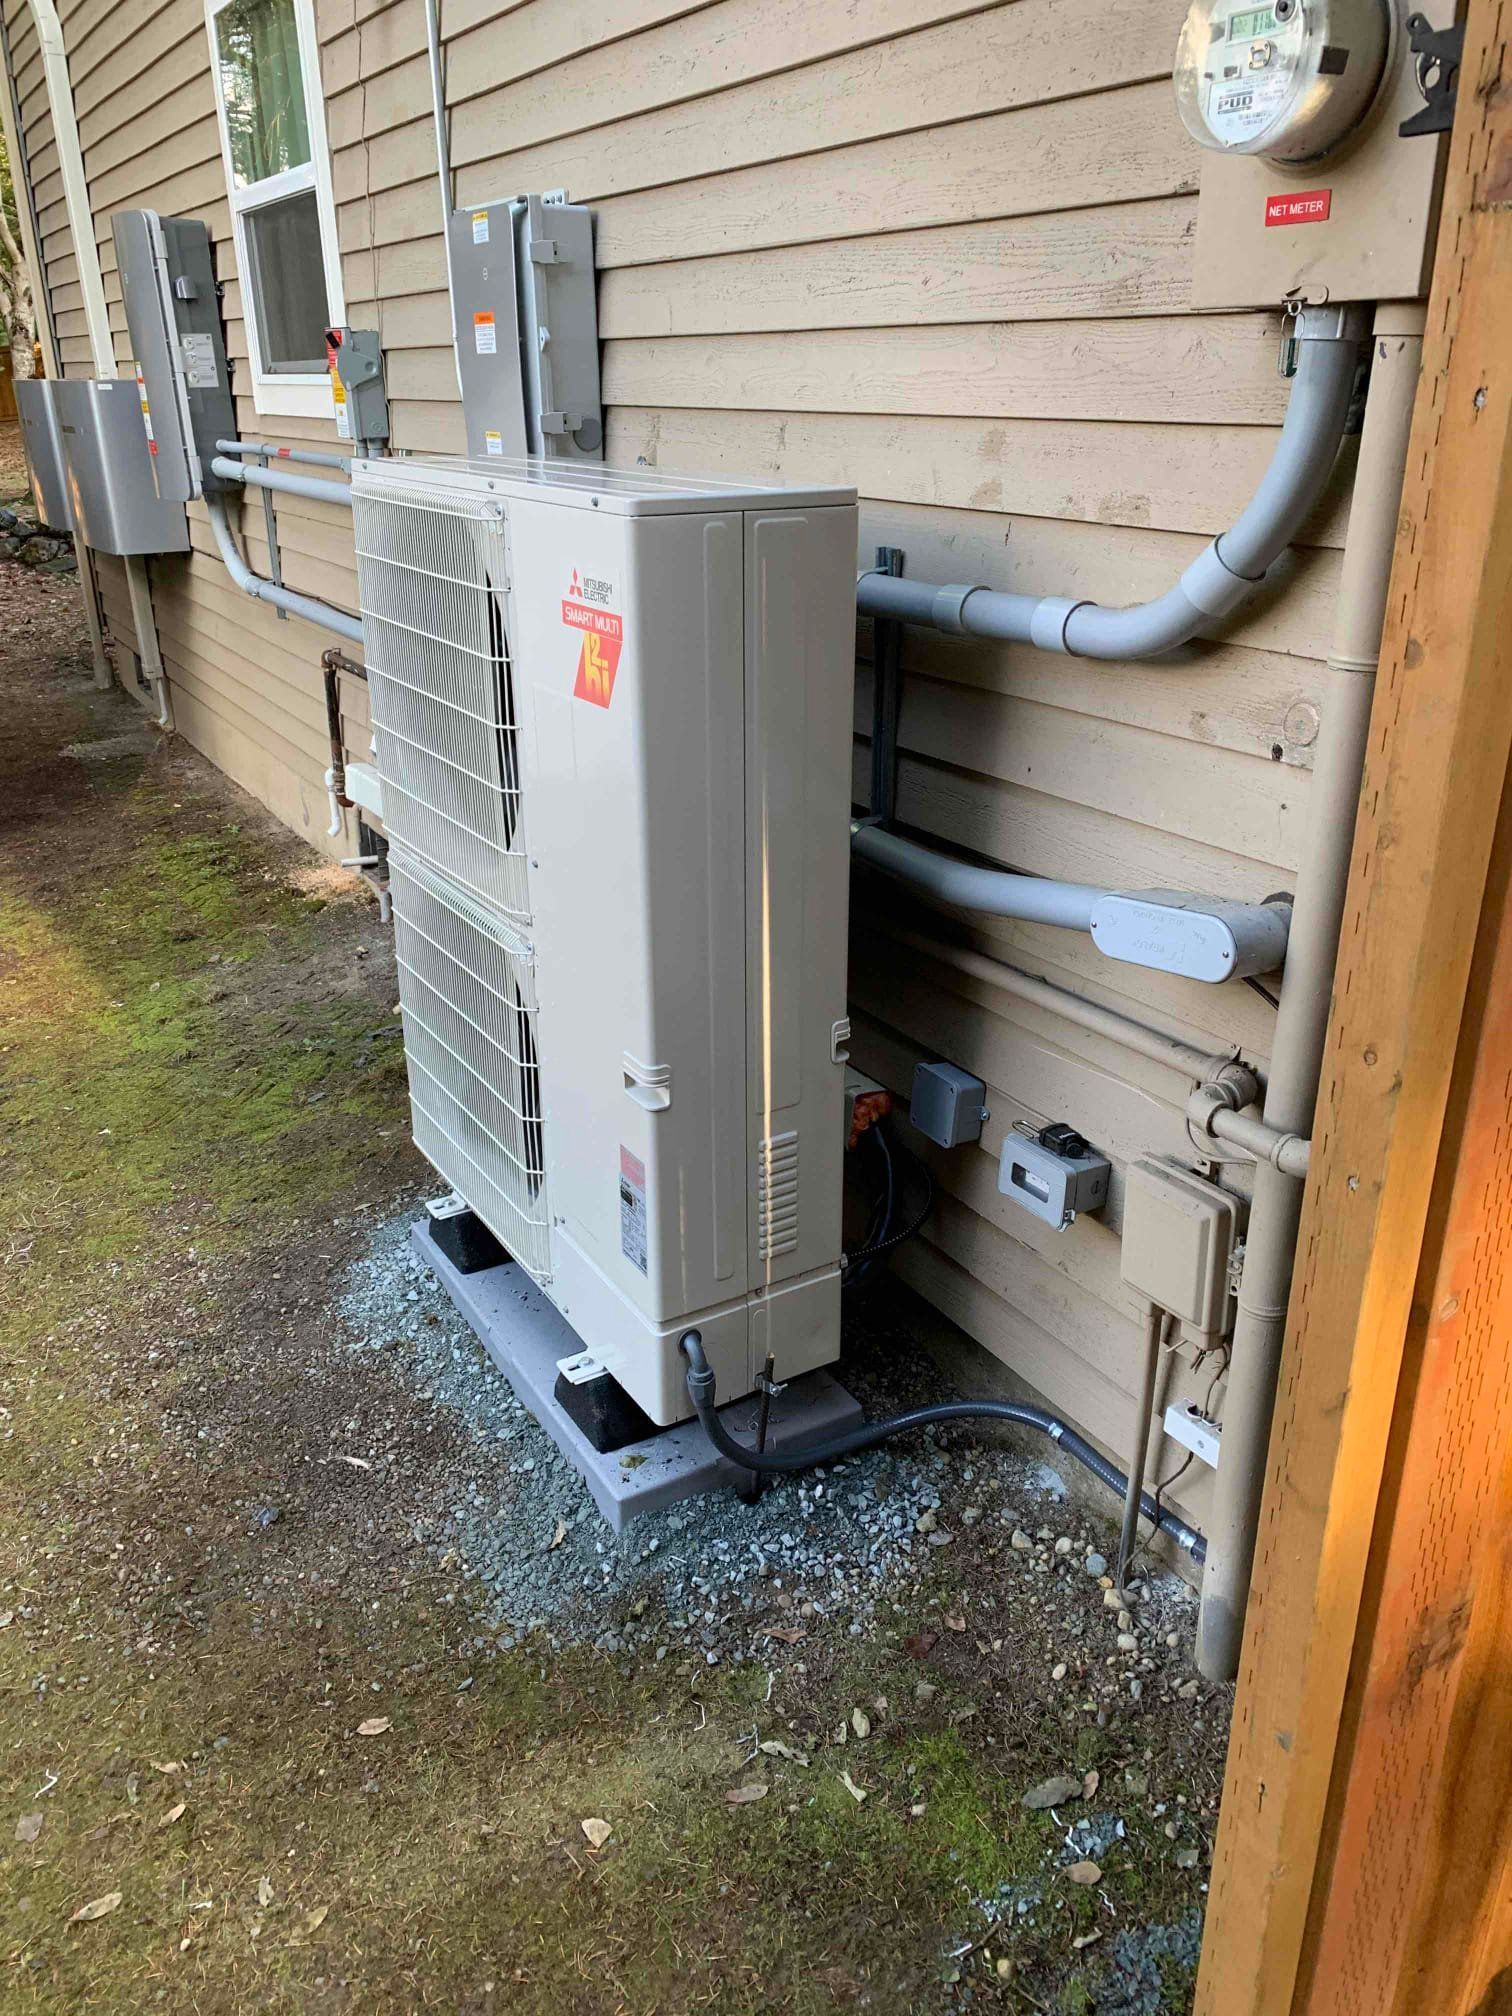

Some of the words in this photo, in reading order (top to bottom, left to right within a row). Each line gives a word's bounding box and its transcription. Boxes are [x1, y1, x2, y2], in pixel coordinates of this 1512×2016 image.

[1218, 95, 1253, 110] PUD
[1269, 204, 1288, 217] NET
[1289, 200, 1324, 215] METER
[583, 577, 612, 595] MITSUBISHI
[583, 588, 609, 605] ELECTRIC
[565, 606, 594, 628] SMART
[594, 614, 619, 636] MULTI
